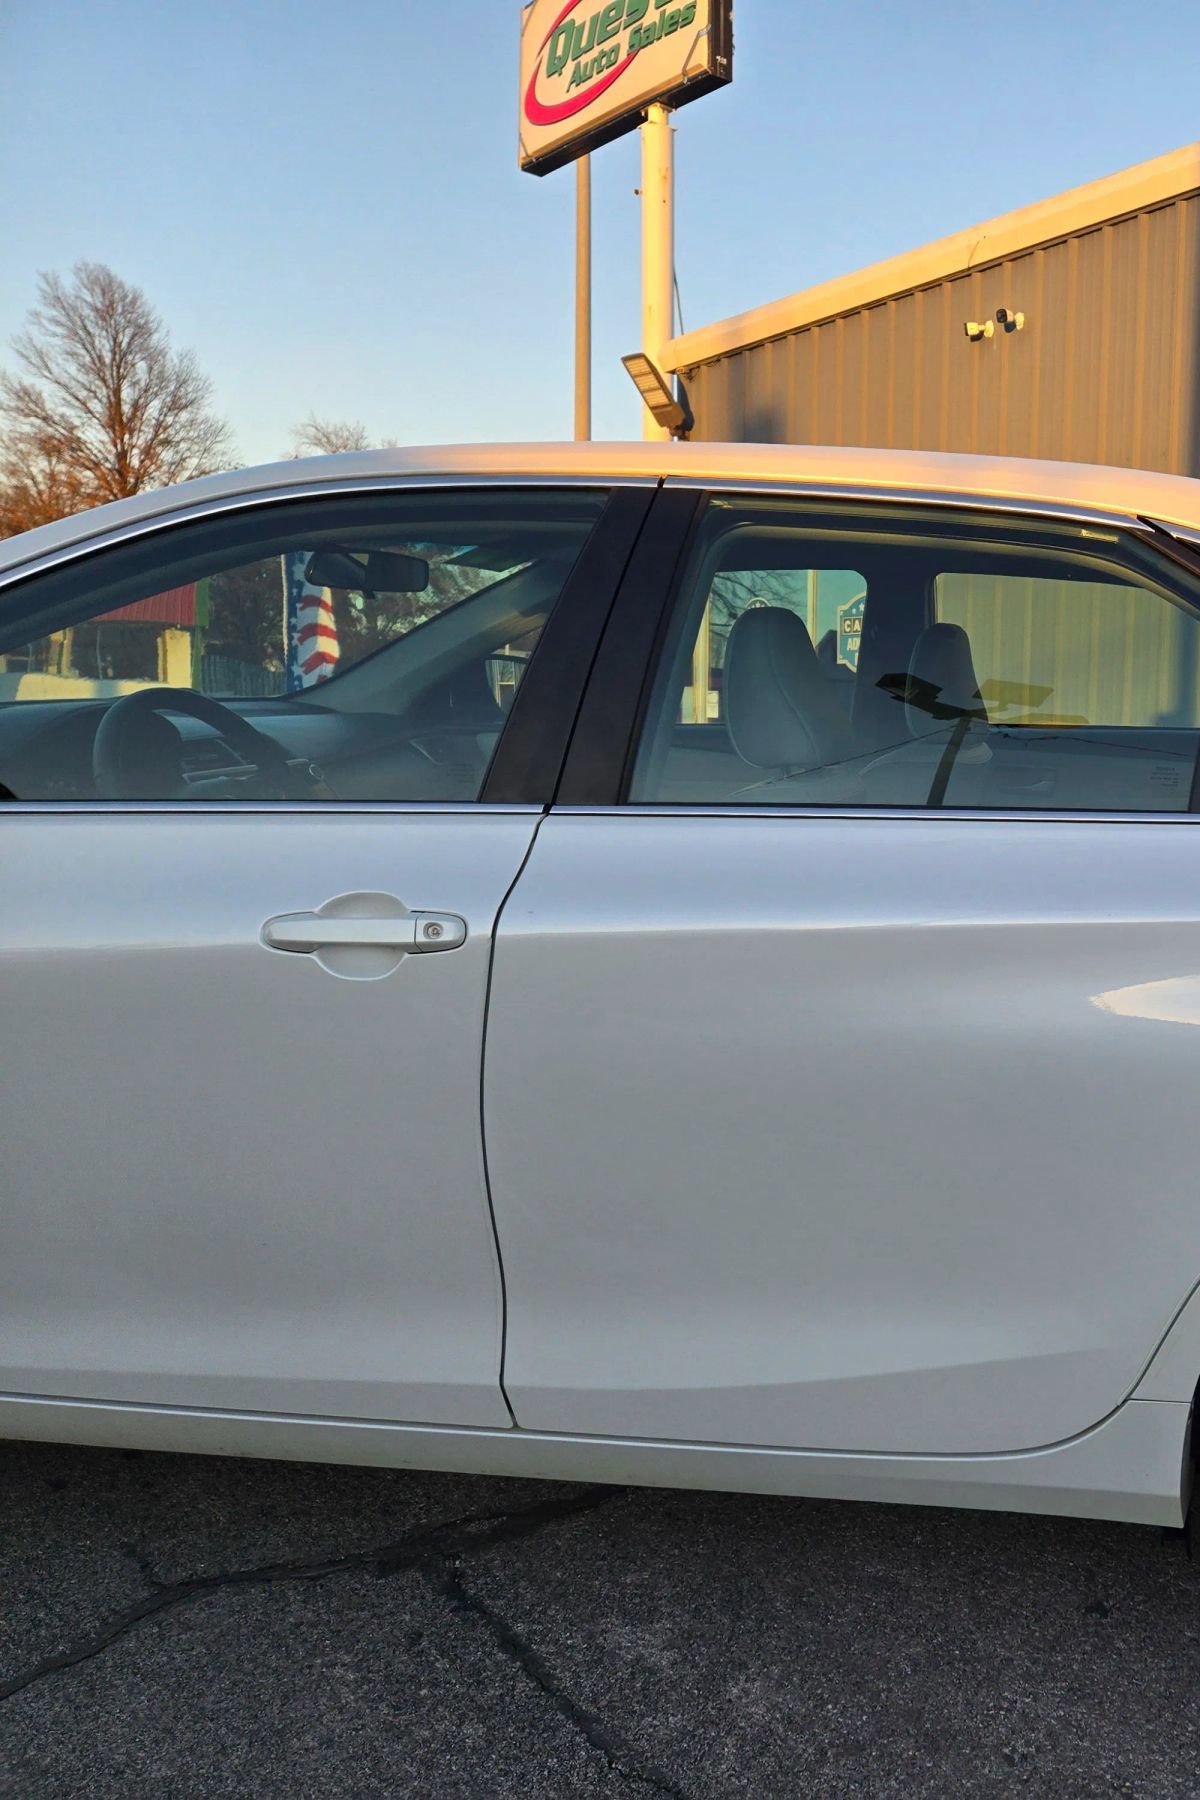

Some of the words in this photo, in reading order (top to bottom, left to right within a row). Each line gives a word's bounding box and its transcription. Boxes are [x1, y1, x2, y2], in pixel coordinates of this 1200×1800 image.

[546, 0, 673, 79] Ques
[566, 42, 621, 93] Auto
[627, 0, 698, 56] Sales
